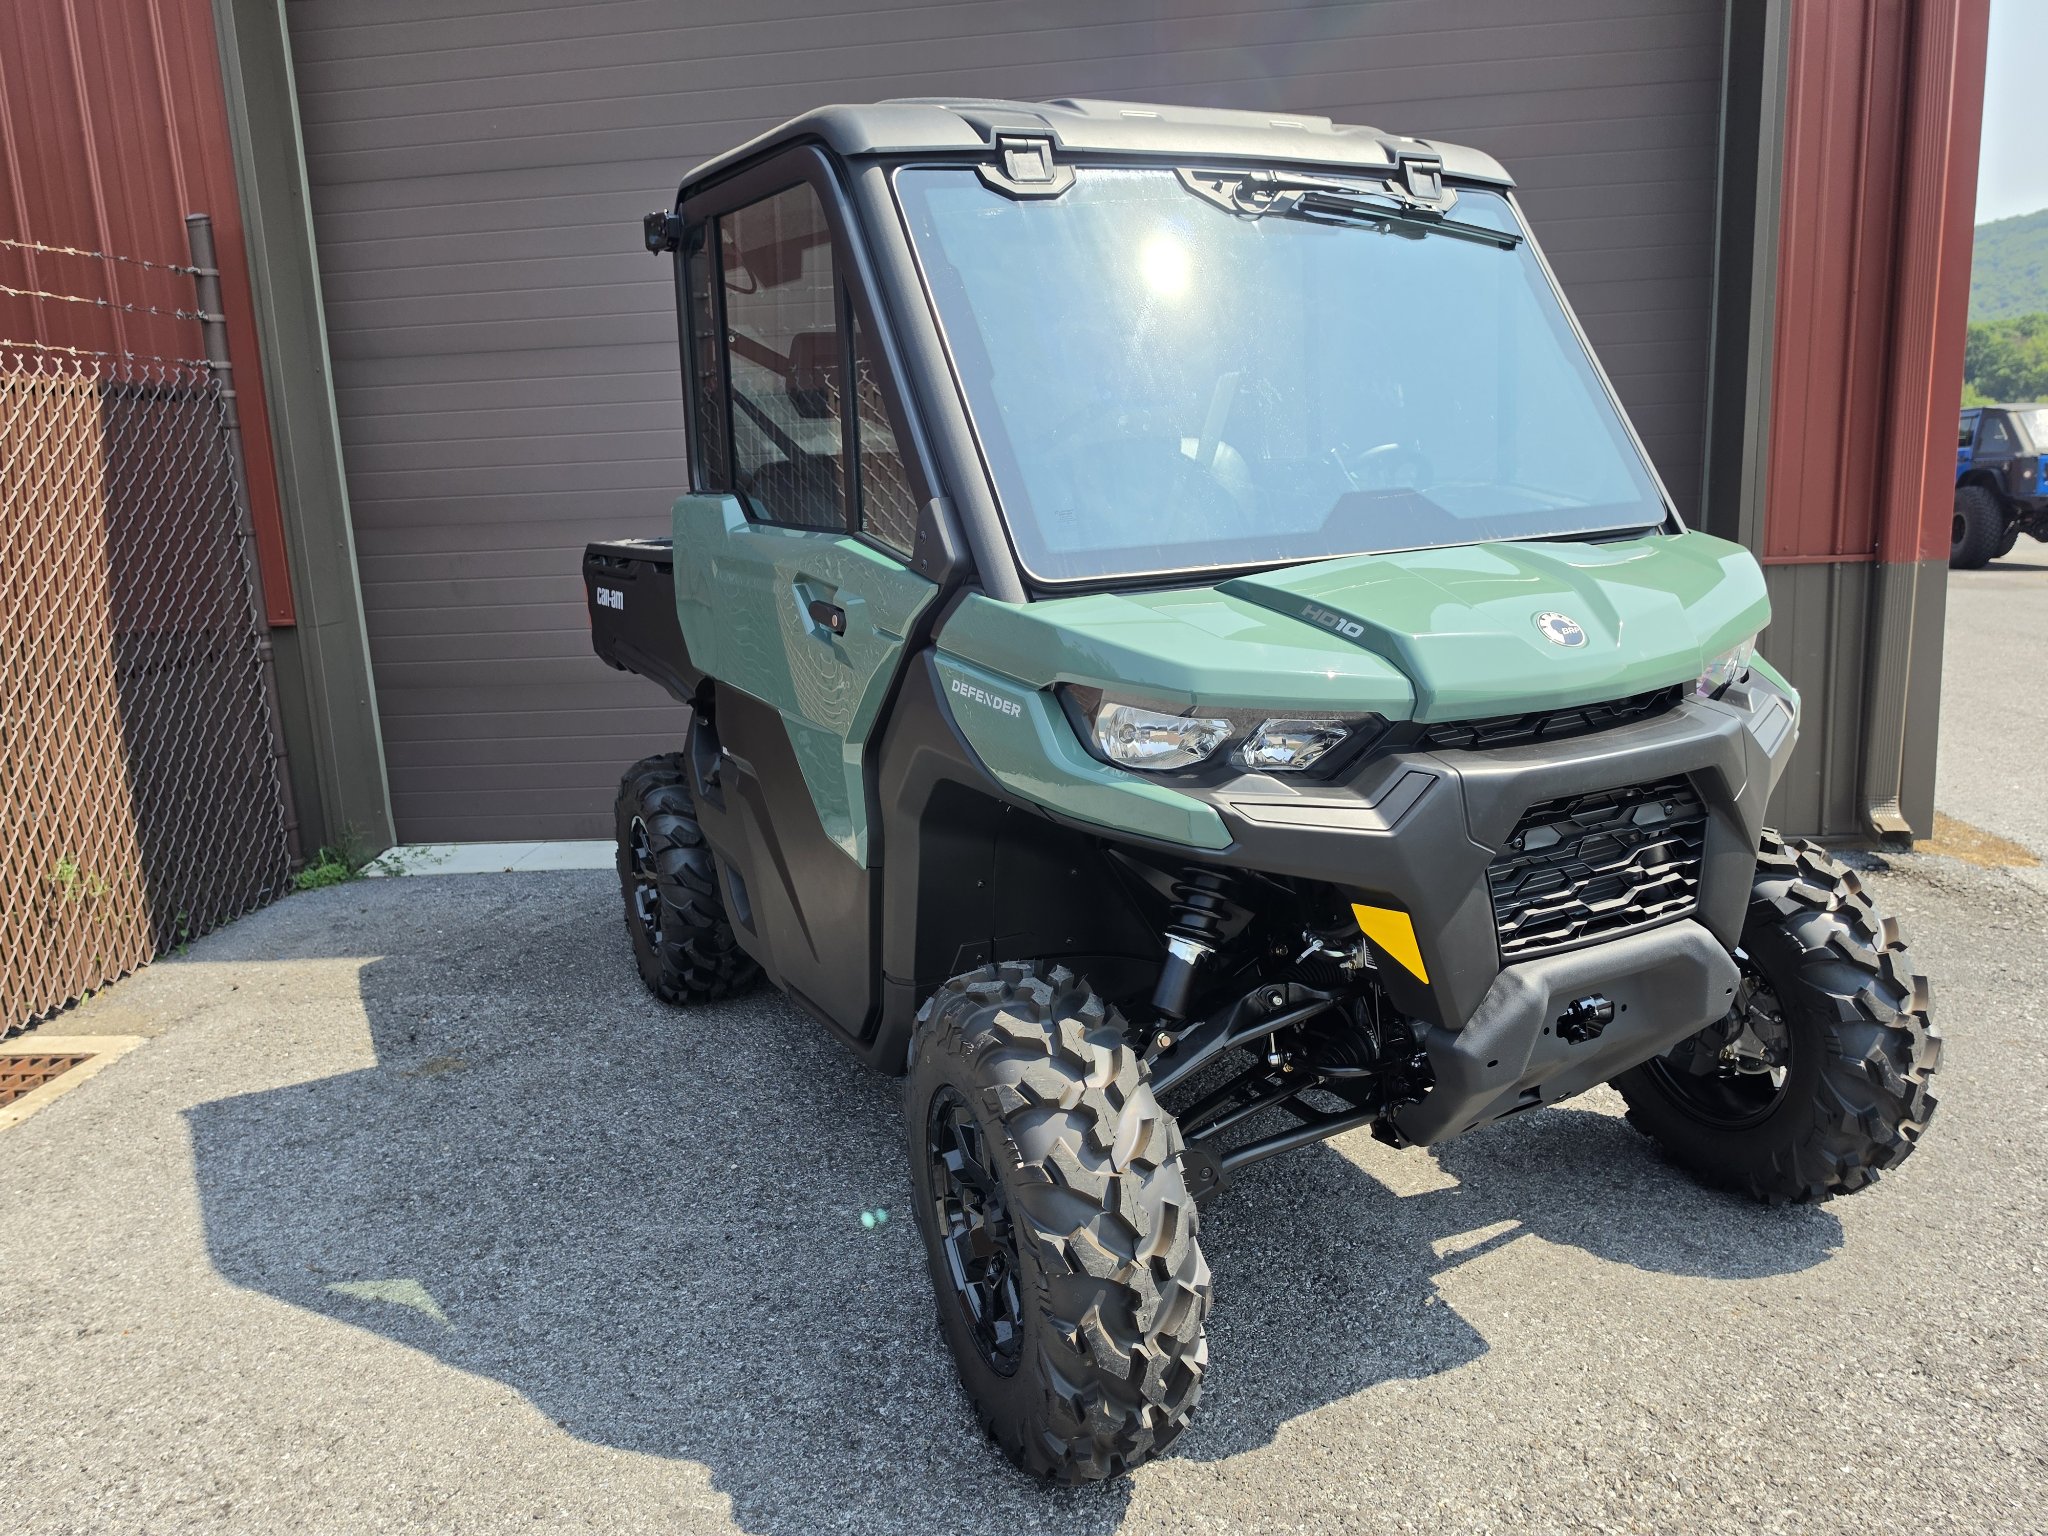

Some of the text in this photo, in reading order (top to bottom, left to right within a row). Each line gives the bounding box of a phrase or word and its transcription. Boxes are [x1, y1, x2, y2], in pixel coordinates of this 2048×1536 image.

[597, 587, 624, 610] can-am
[1301, 604, 1365, 638] HD10
[951, 679, 1021, 718] DEFENDER
